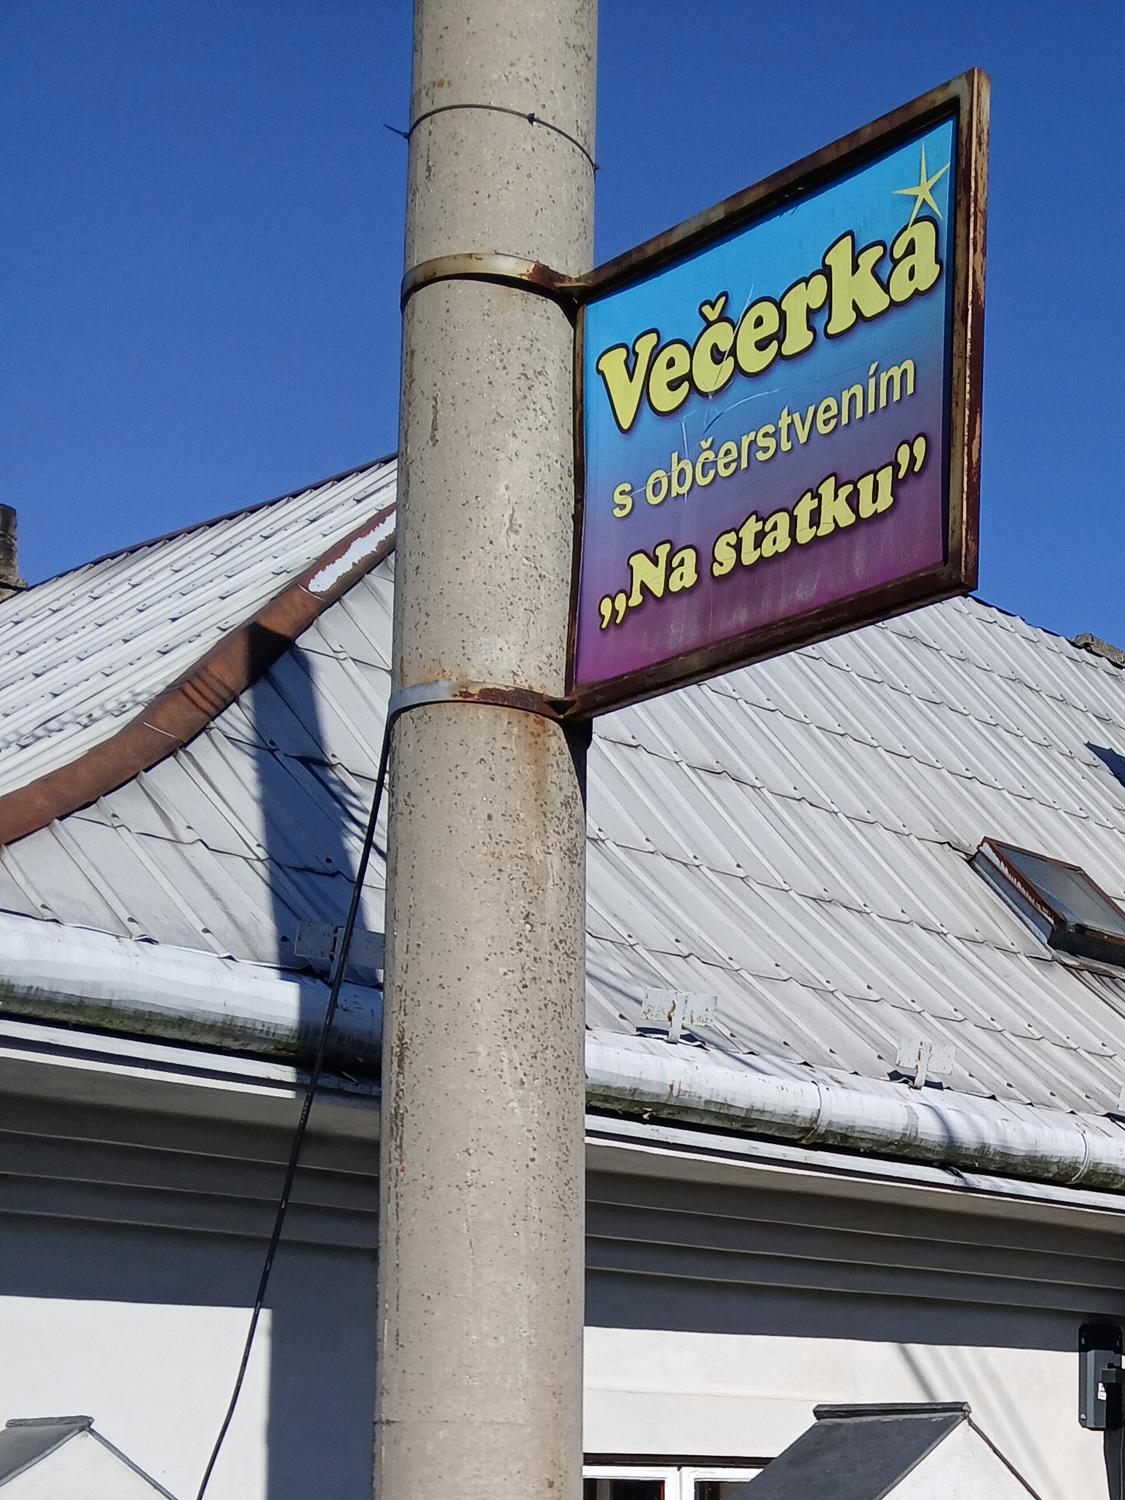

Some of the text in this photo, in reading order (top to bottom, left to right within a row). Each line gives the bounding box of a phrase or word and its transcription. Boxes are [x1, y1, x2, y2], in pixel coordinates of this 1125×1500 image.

[597, 214, 944, 435] Večerka
[612, 357, 917, 519] s občerstvením
